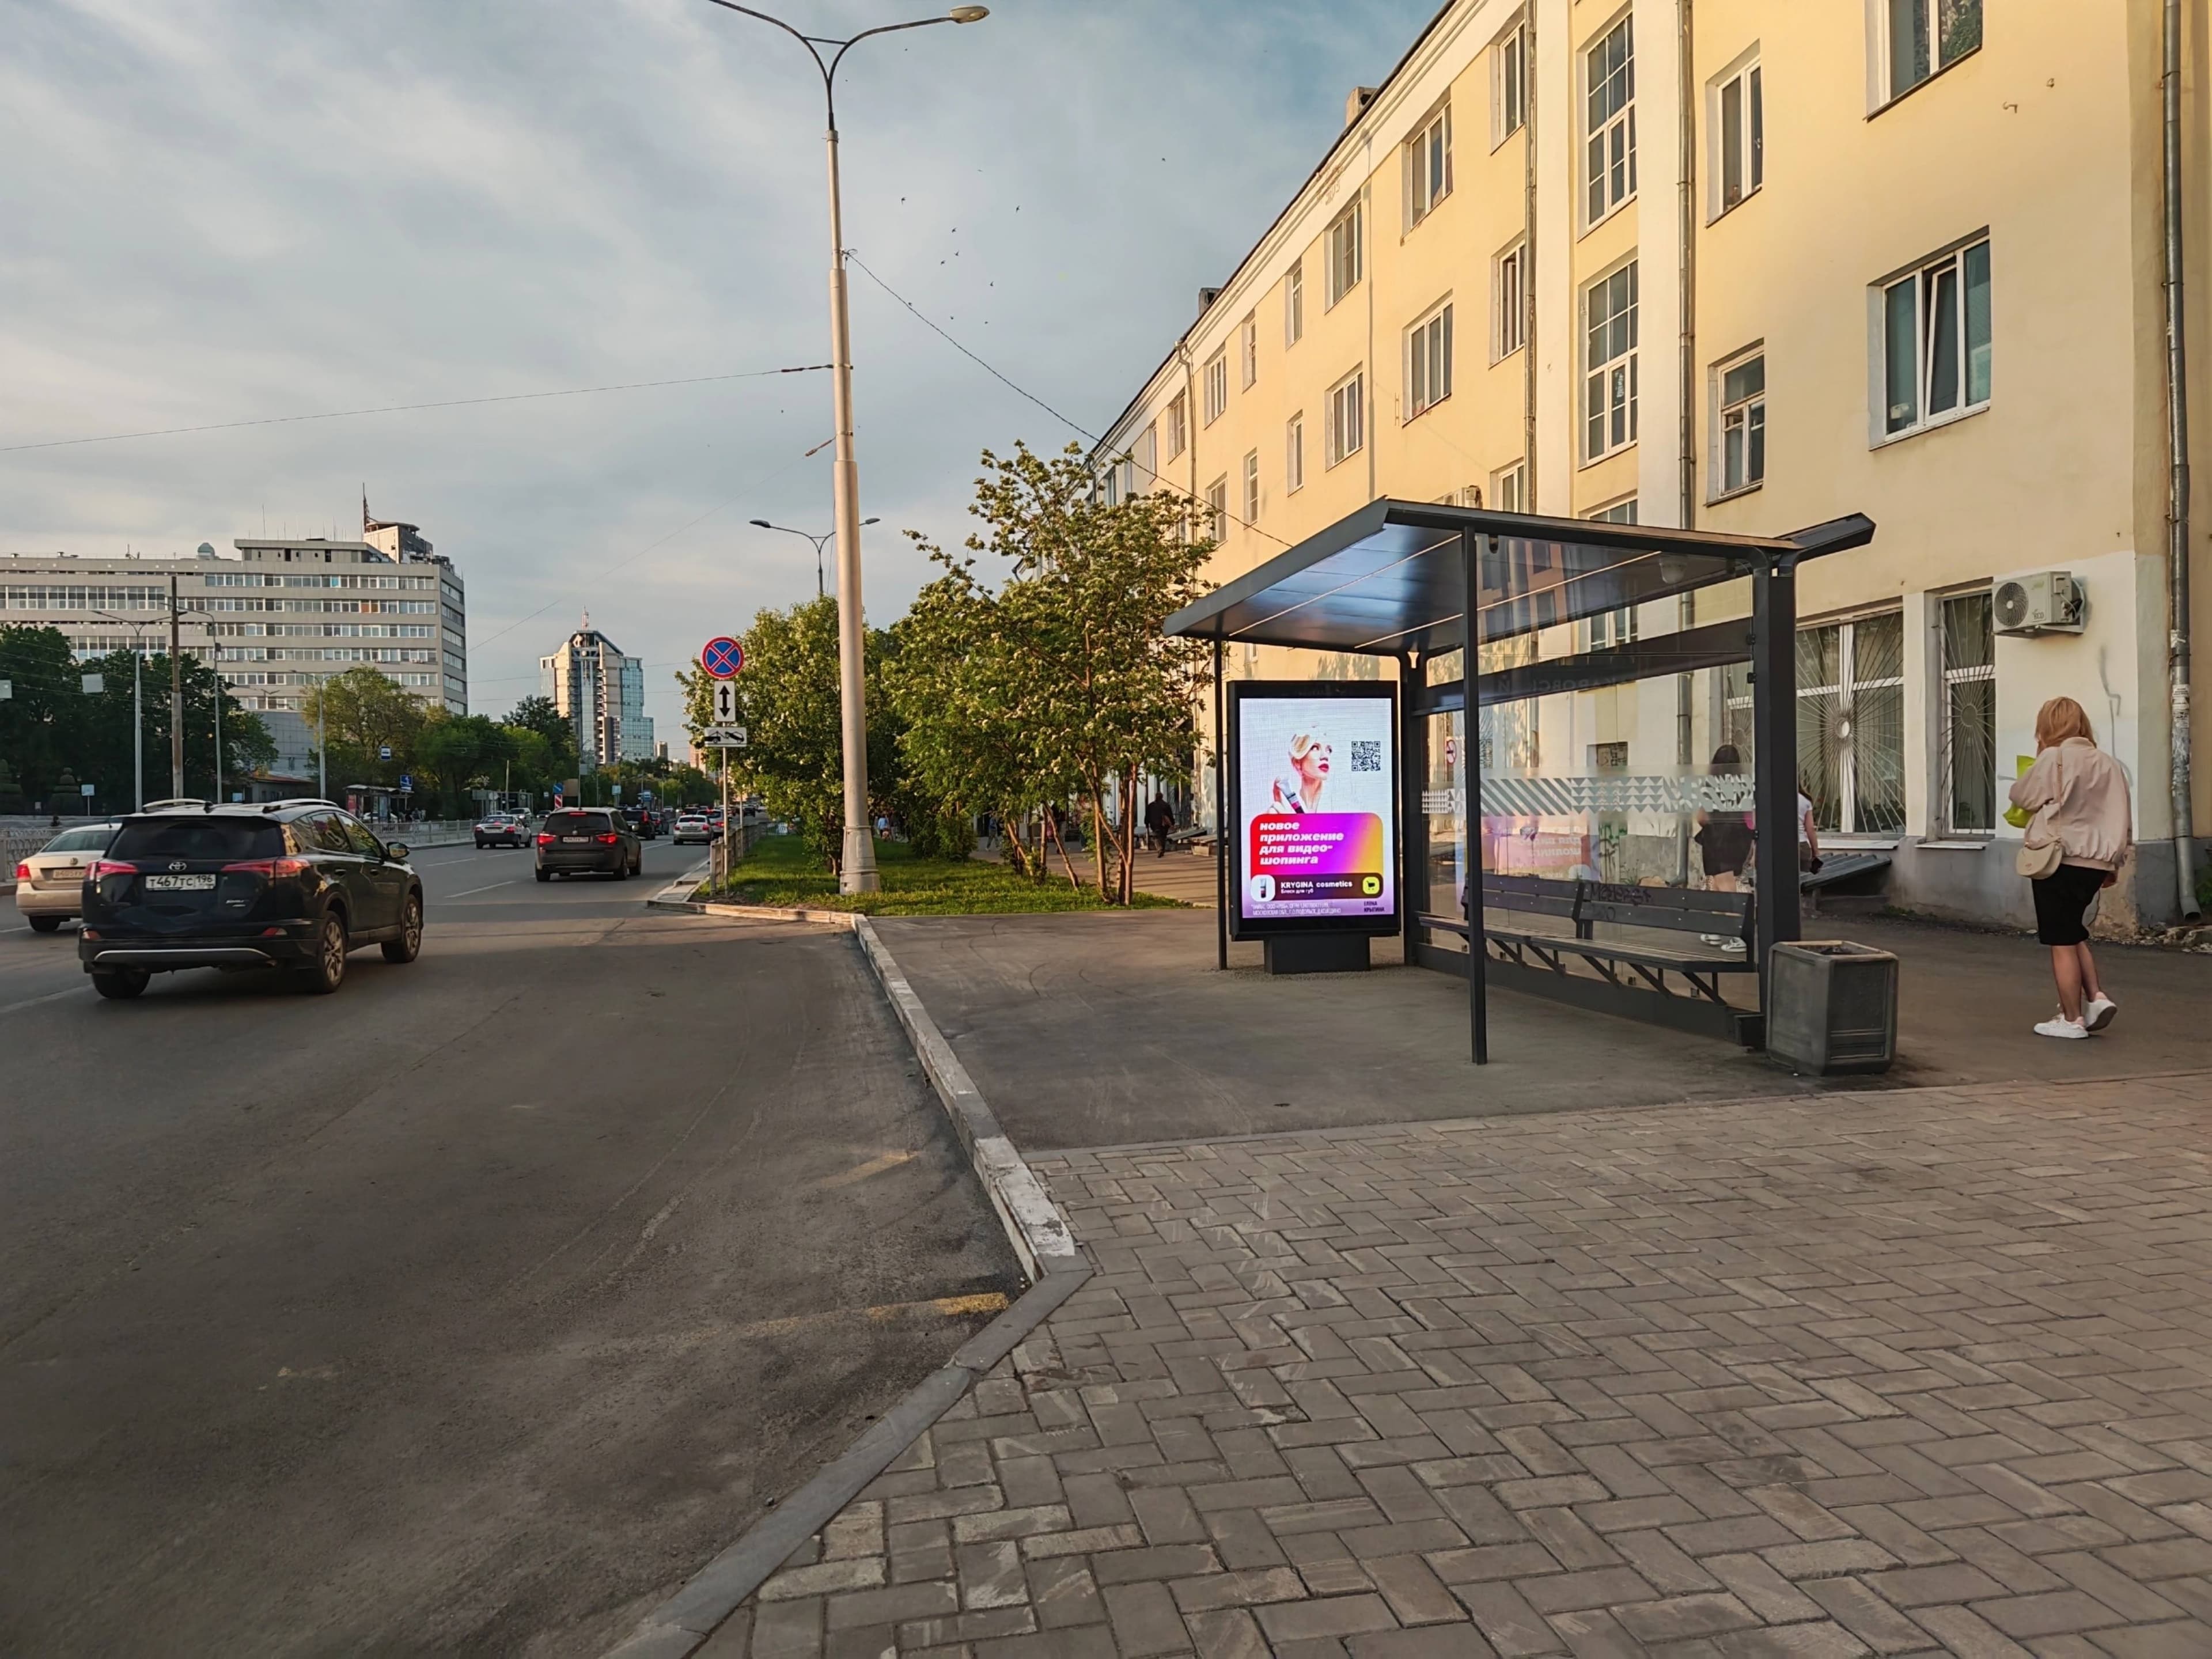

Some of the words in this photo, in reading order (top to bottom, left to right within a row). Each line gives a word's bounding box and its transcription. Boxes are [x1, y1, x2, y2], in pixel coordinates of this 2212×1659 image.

[1260, 822, 1300, 831] новое
[1260, 832, 1344, 844] приложение
[1259, 845, 1285, 855] для
[1287, 844, 1333, 854] видео-
[1260, 856, 1319, 865] шопинга
[196, 874, 213, 883] 196
[1281, 881, 1313, 889] KRYGINA
